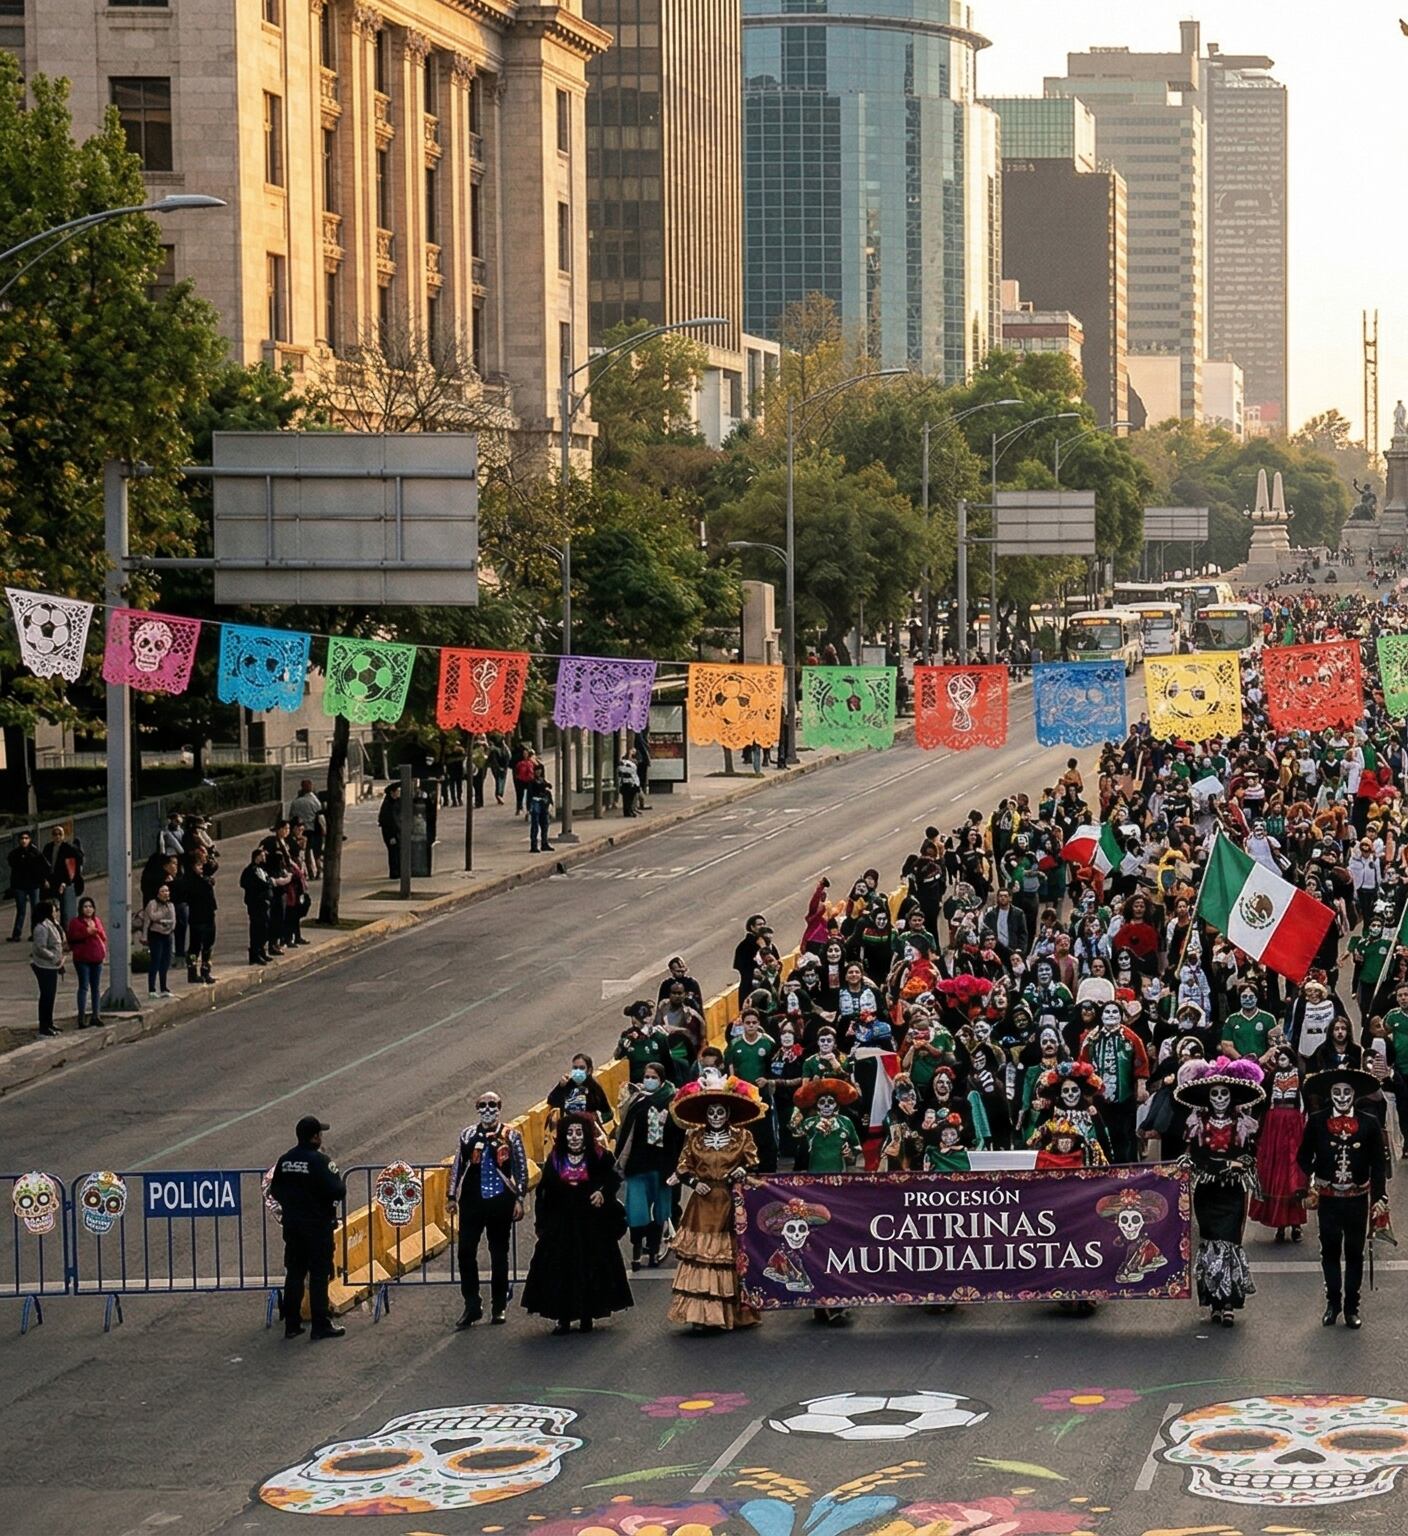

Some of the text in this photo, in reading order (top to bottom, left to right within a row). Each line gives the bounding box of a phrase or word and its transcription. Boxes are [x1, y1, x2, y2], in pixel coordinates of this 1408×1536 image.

[150, 1180, 235, 1209] POLICIA
[903, 1187, 1020, 1207] PROCESIÓN
[869, 1210, 1057, 1241] CATRINAS
[824, 1241, 1104, 1275] MUNDIALISTAS
